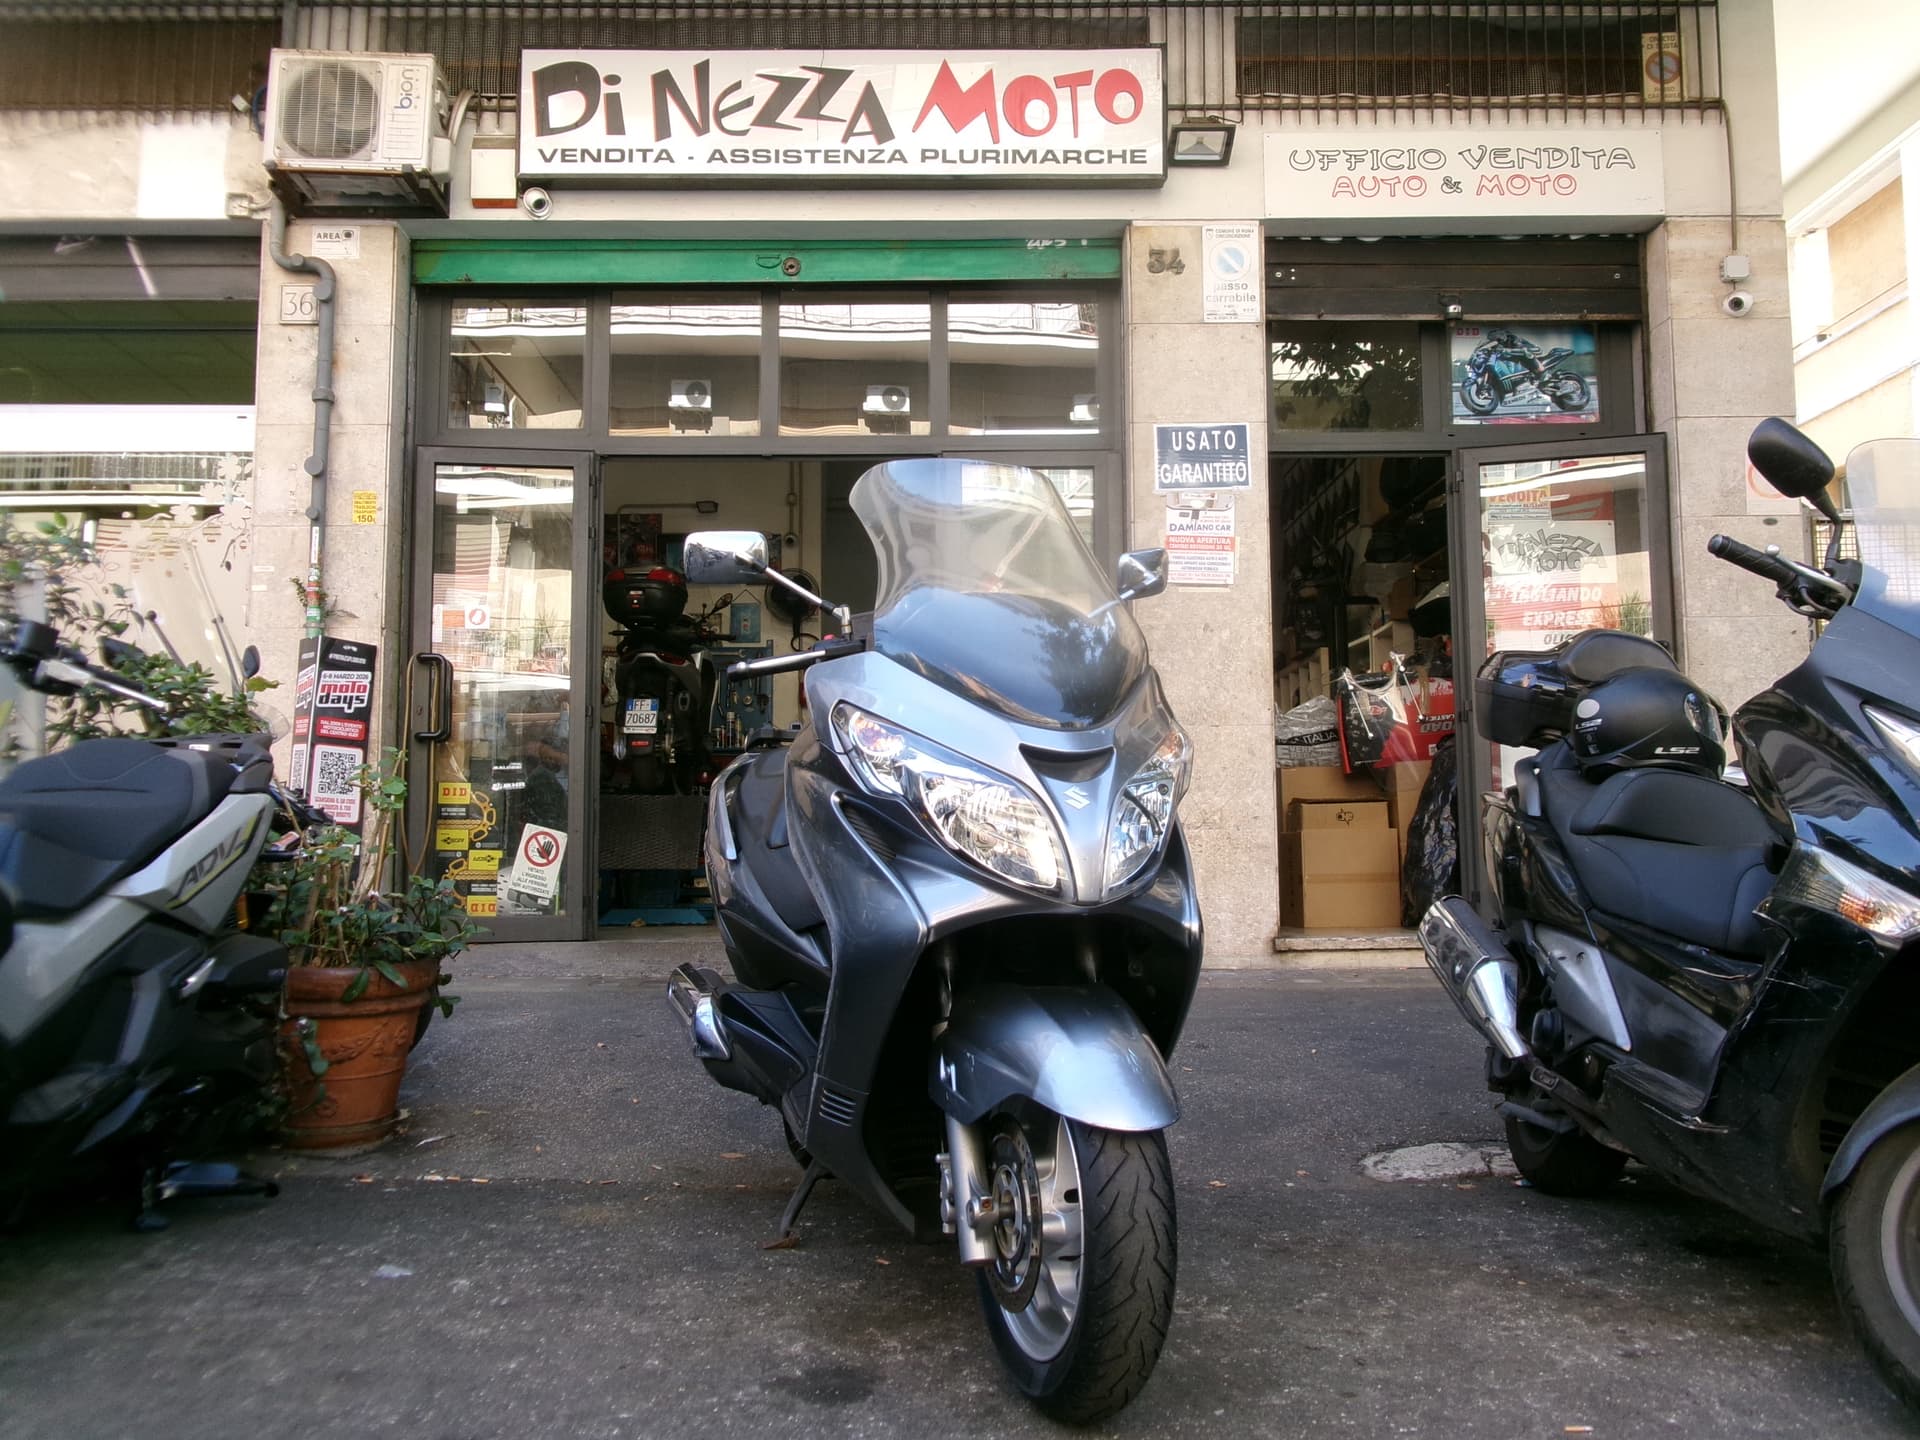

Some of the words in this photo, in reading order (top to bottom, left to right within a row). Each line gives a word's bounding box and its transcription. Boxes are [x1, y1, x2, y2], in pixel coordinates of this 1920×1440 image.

[394, 68, 415, 111] bion
[912, 58, 1144, 145] MOTO
[537, 147, 676, 164] VENDITA
[706, 147, 908, 164] ASSISTENZA
[920, 147, 1148, 165] PLURIMARCHE
[1288, 148, 1447, 172] UFFICIO
[1458, 144, 1636, 171] VENDITA
[1332, 174, 1428, 198] AUTO
[1440, 175, 1463, 195] &
[1475, 173, 1577, 197] MOTO
[315, 232, 341, 240] AREA
[283, 290, 313, 316] 36
[1172, 429, 1236, 452] USATO
[1160, 462, 1247, 485] GARANTITO
[1169, 523, 1214, 532] DAMIANO
[1215, 523, 1232, 532] CAR
[1168, 536, 1194, 545] NUOVA
[1198, 537, 1231, 545] APERTURA
[320, 681, 368, 693] moto
[318, 692, 366, 710] days
[626, 713, 656, 724] 70687
[1654, 746, 1700, 755] LS2
[442, 787, 467, 796] DID
[174, 826, 243, 899] ADV
